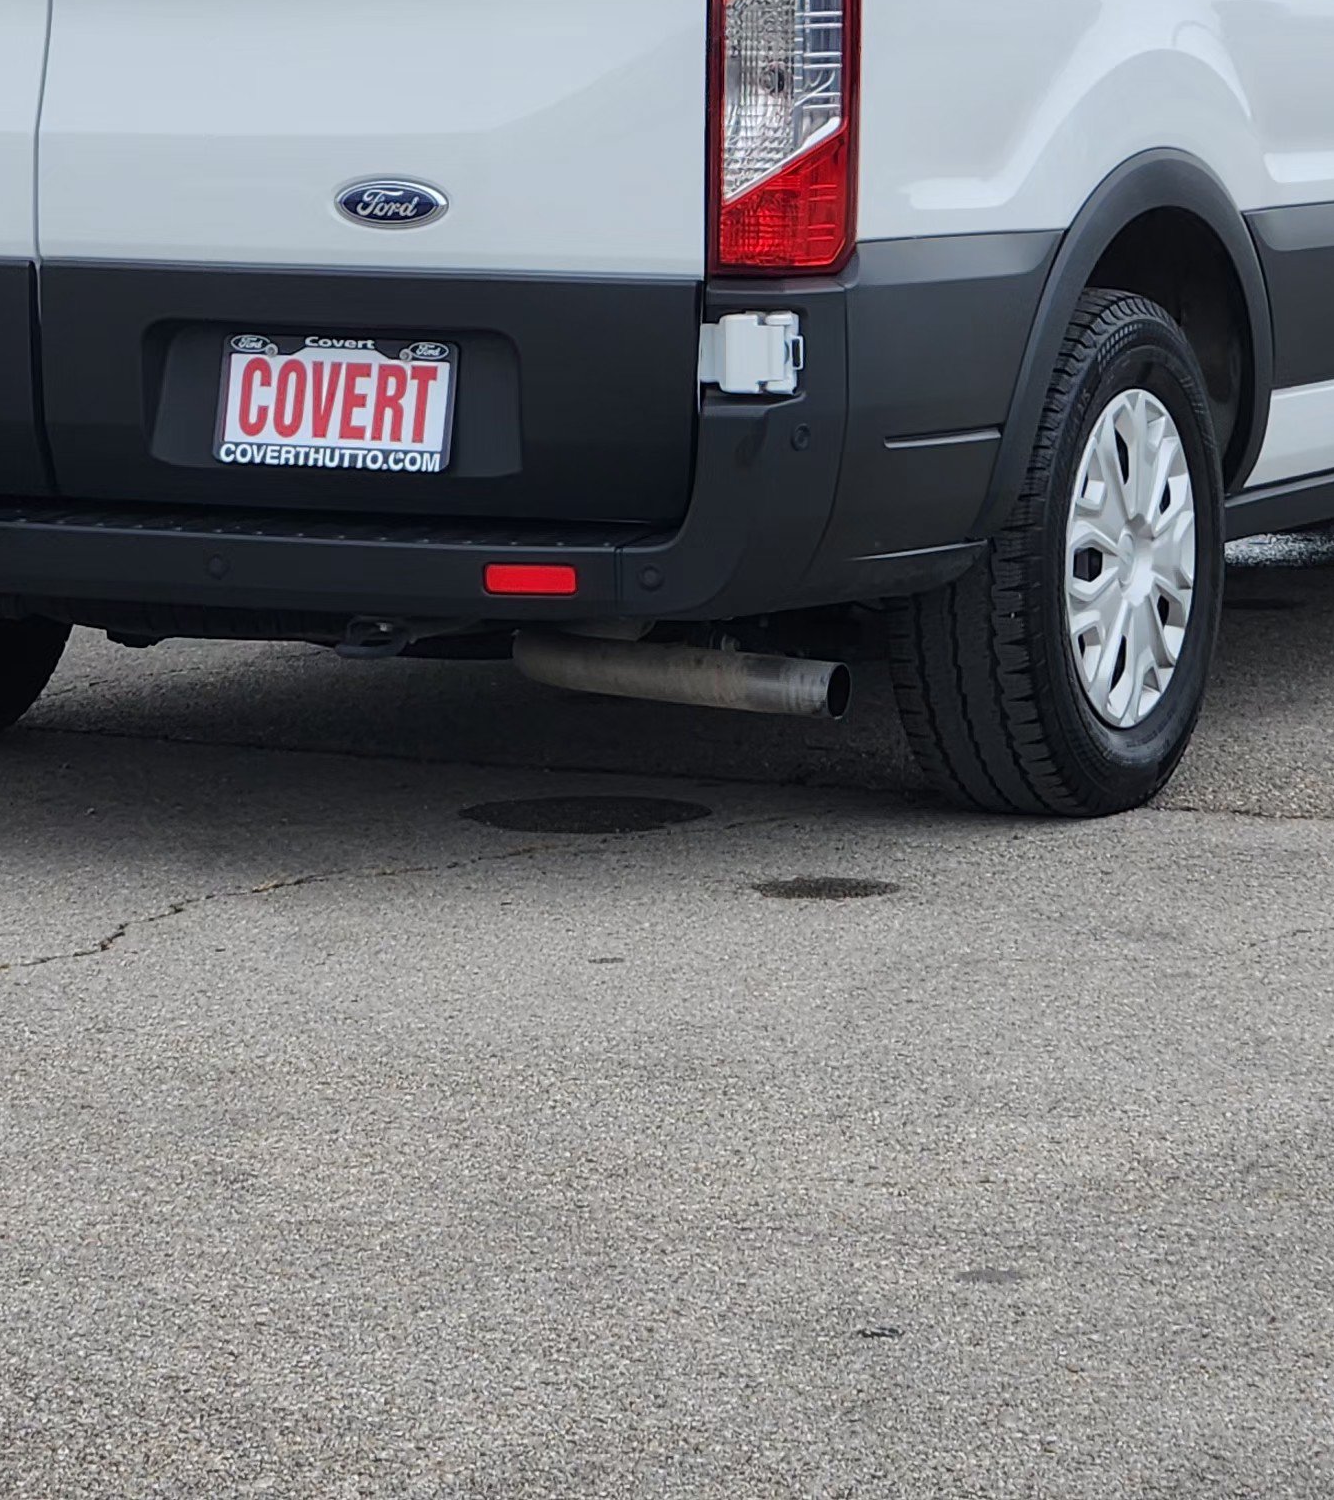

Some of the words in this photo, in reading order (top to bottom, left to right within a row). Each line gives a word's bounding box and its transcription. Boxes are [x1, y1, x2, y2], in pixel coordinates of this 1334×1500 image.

[356, 189, 419, 217] Ford
[238, 337, 264, 348] Ford
[305, 336, 375, 349] Covert
[416, 344, 442, 356] Ford
[238, 357, 438, 444] COVERT
[219, 443, 441, 473] COVERTHUTTO.COM
